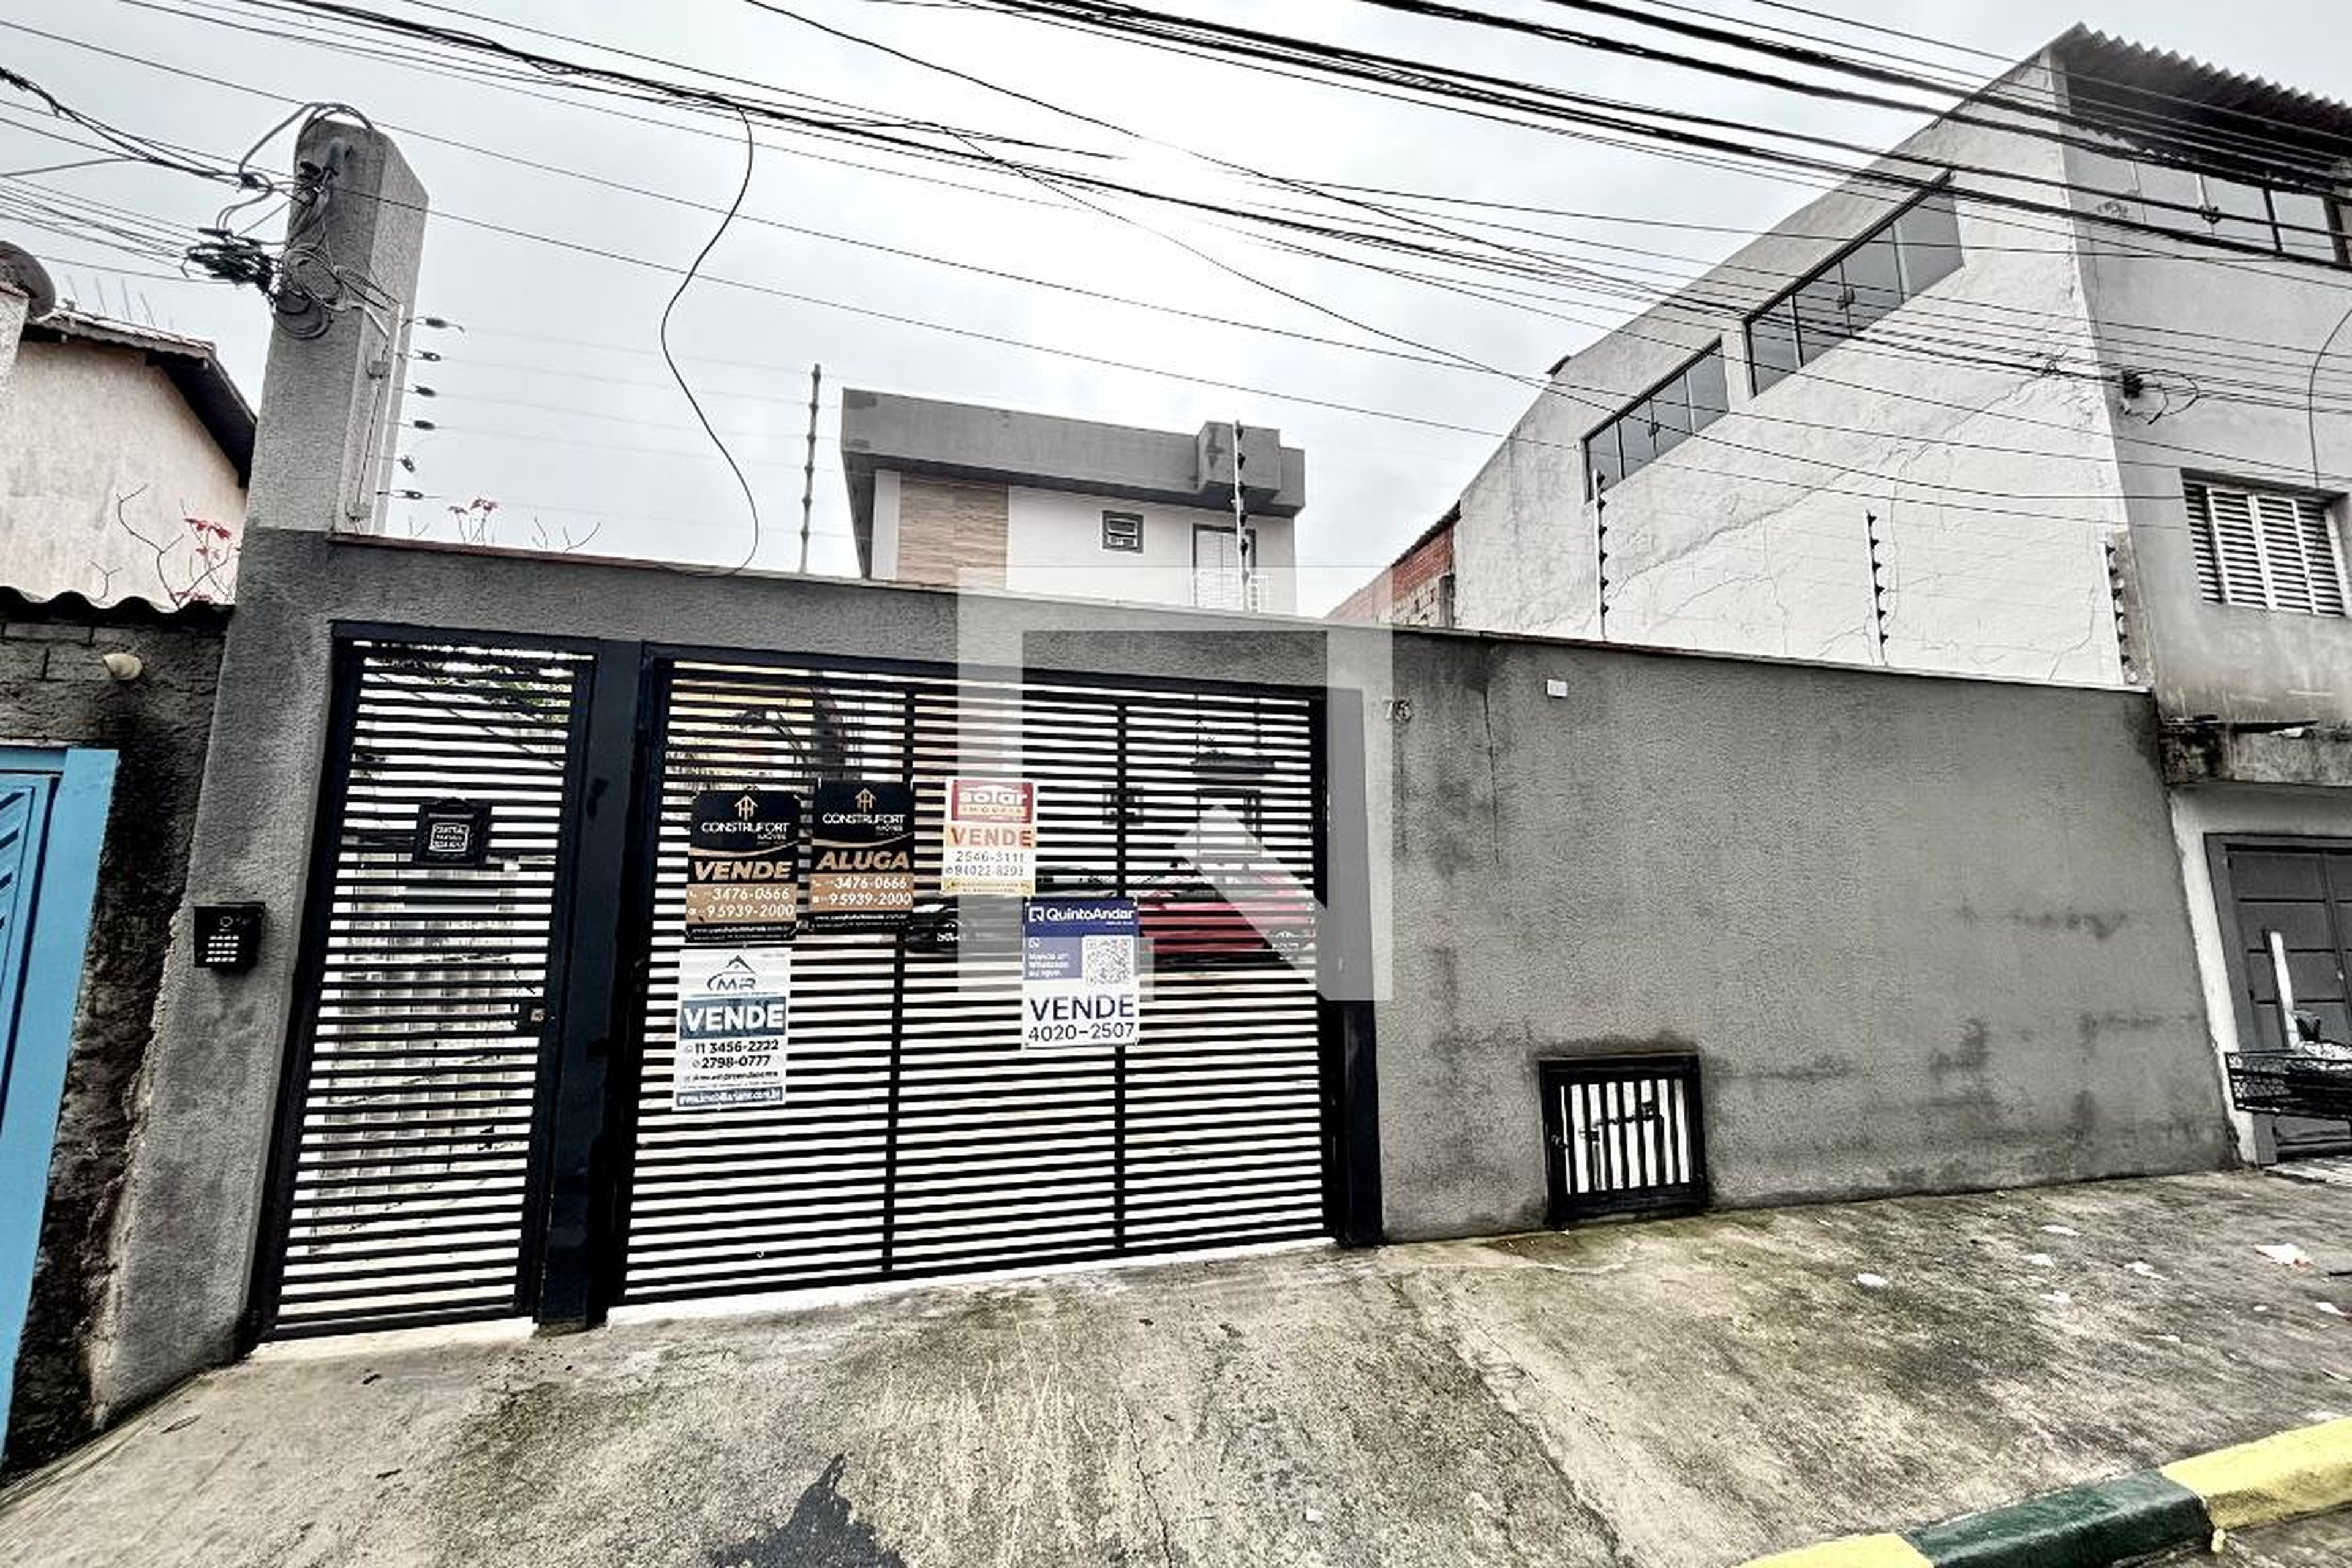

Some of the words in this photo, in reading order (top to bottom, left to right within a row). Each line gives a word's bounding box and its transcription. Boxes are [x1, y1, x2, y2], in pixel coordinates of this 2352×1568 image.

[822, 813, 907, 824] CONSTRUFORT
[701, 821, 791, 833] CONSTRUFORT
[951, 828, 1032, 847] VENDE
[815, 850, 910, 870] ALUGA
[693, 861, 793, 881] VENDE
[834, 876, 908, 889] 3476-0666
[712, 887, 790, 901] 3476-0666
[828, 892, 913, 905] 95939-2000
[707, 903, 795, 918] 95939-2000
[1046, 907, 1135, 921] QuintoAndar
[1030, 994, 1135, 1021] VENDE
[684, 1003, 785, 1032] VENDE
[1028, 1022, 1135, 1042] 4020-2507
[709, 1039, 780, 1053] 3456-2222
[701, 1055, 771, 1069] 2798-0777
